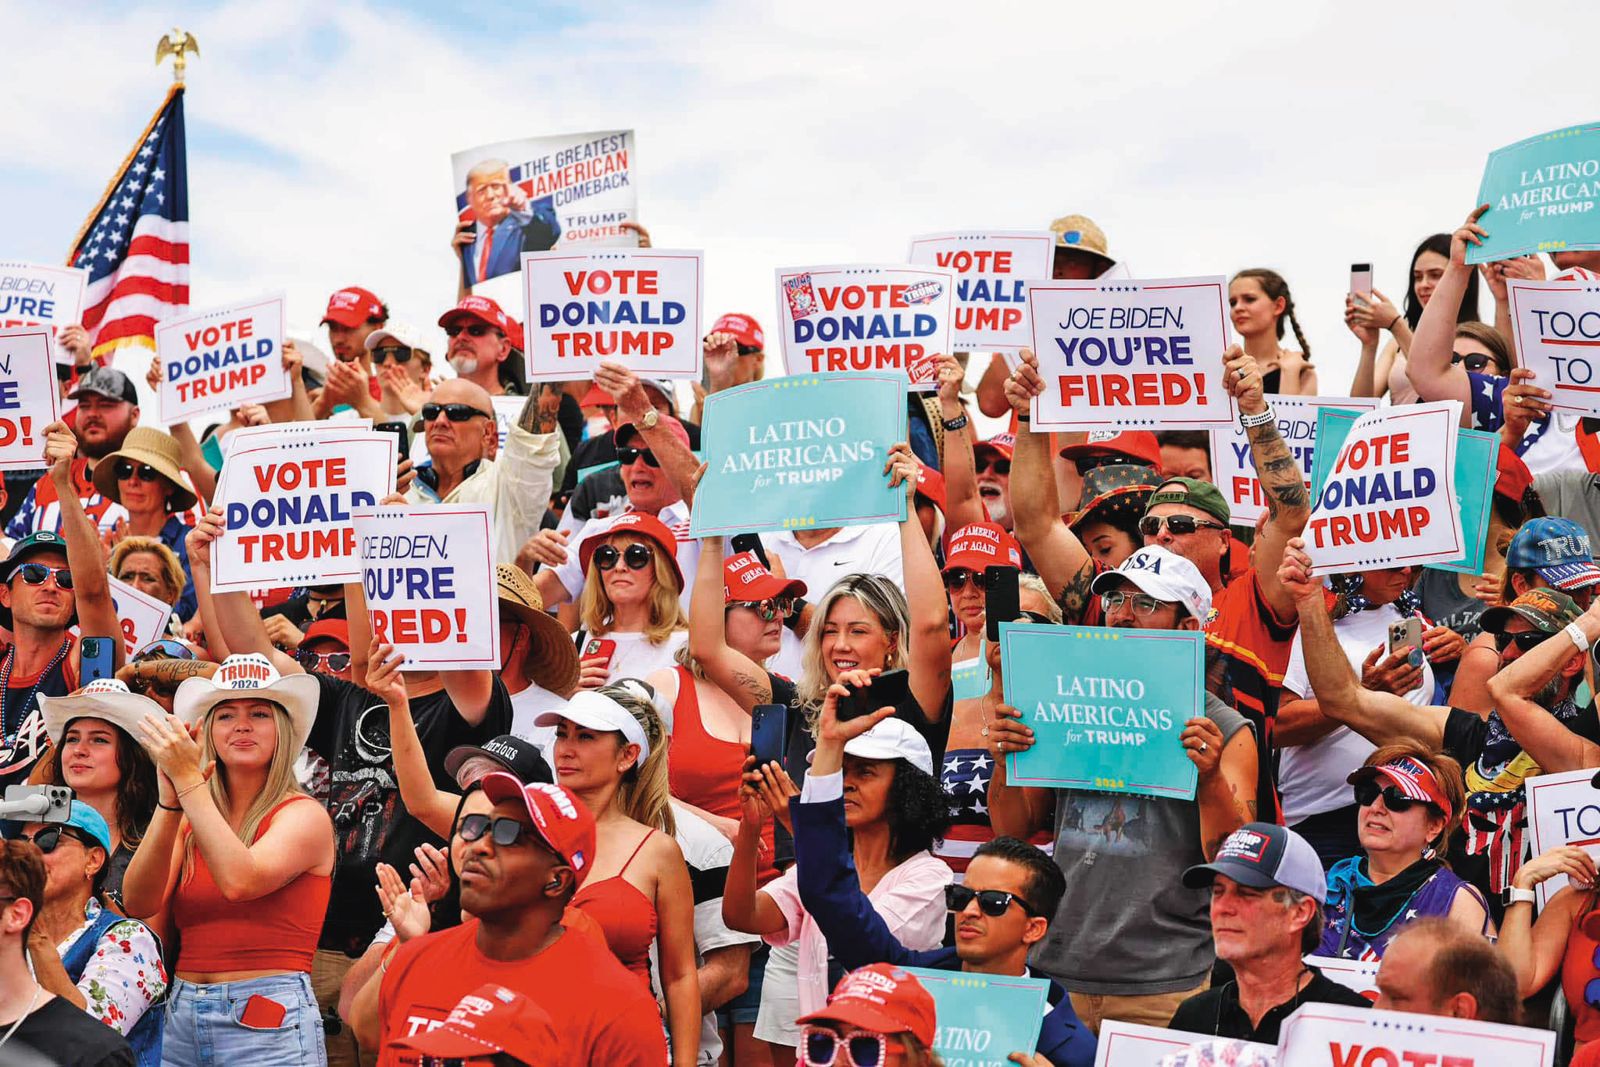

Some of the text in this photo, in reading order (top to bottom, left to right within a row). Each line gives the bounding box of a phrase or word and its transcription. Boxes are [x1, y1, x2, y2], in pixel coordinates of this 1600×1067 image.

[524, 133, 627, 179] THE GREATEST
[536, 150, 628, 196] AMERICAN
[1521, 160, 1599, 186] LATINO
[556, 171, 630, 207] COMEBACK
[566, 212, 628, 227] TRUMP
[1516, 201, 1595, 225] for TRUMP
[566, 226, 628, 240] GUNTER
[936, 251, 1013, 273] VOTE
[563, 270, 659, 295] VOTE
[0, 296, 55, 319] U'RE
[818, 285, 911, 311] VOTE
[540, 301, 686, 327] DONALD
[955, 307, 1023, 331] UMP
[1059, 306, 1184, 330] JOE BIDEN,
[185, 318, 253, 351] VOTE
[794, 313, 938, 343] DONALD
[551, 331, 674, 357] TRUMP
[1055, 336, 1193, 366] YOU'RE
[168, 338, 273, 382] DONALD
[805, 343, 926, 372] TRUMP
[1548, 356, 1592, 384] TO
[176, 364, 266, 403] TRUMP
[1058, 373, 1208, 407] FIRED!
[749, 417, 845, 445] LATINO
[1278, 420, 1317, 440] BIDE
[720, 440, 874, 475] AMERICANS
[253, 457, 346, 493] VOTE
[751, 468, 843, 493] for TRUMP
[966, 525, 1000, 543] AMERICA
[1310, 506, 1430, 548] TRUMP
[362, 534, 448, 560] OE BIDEN,
[970, 541, 996, 556] AGAIN
[363, 567, 456, 600] OU'RE
[368, 608, 468, 645] RED!
[220, 663, 271, 682] TRUMP
[231, 680, 259, 689] 2024
[1056, 675, 1145, 700] LATINO
[1033, 702, 1173, 730] AMERICANS
[1063, 730, 1146, 747] for TRUMP
[935, 1027, 991, 1052] ATINO
